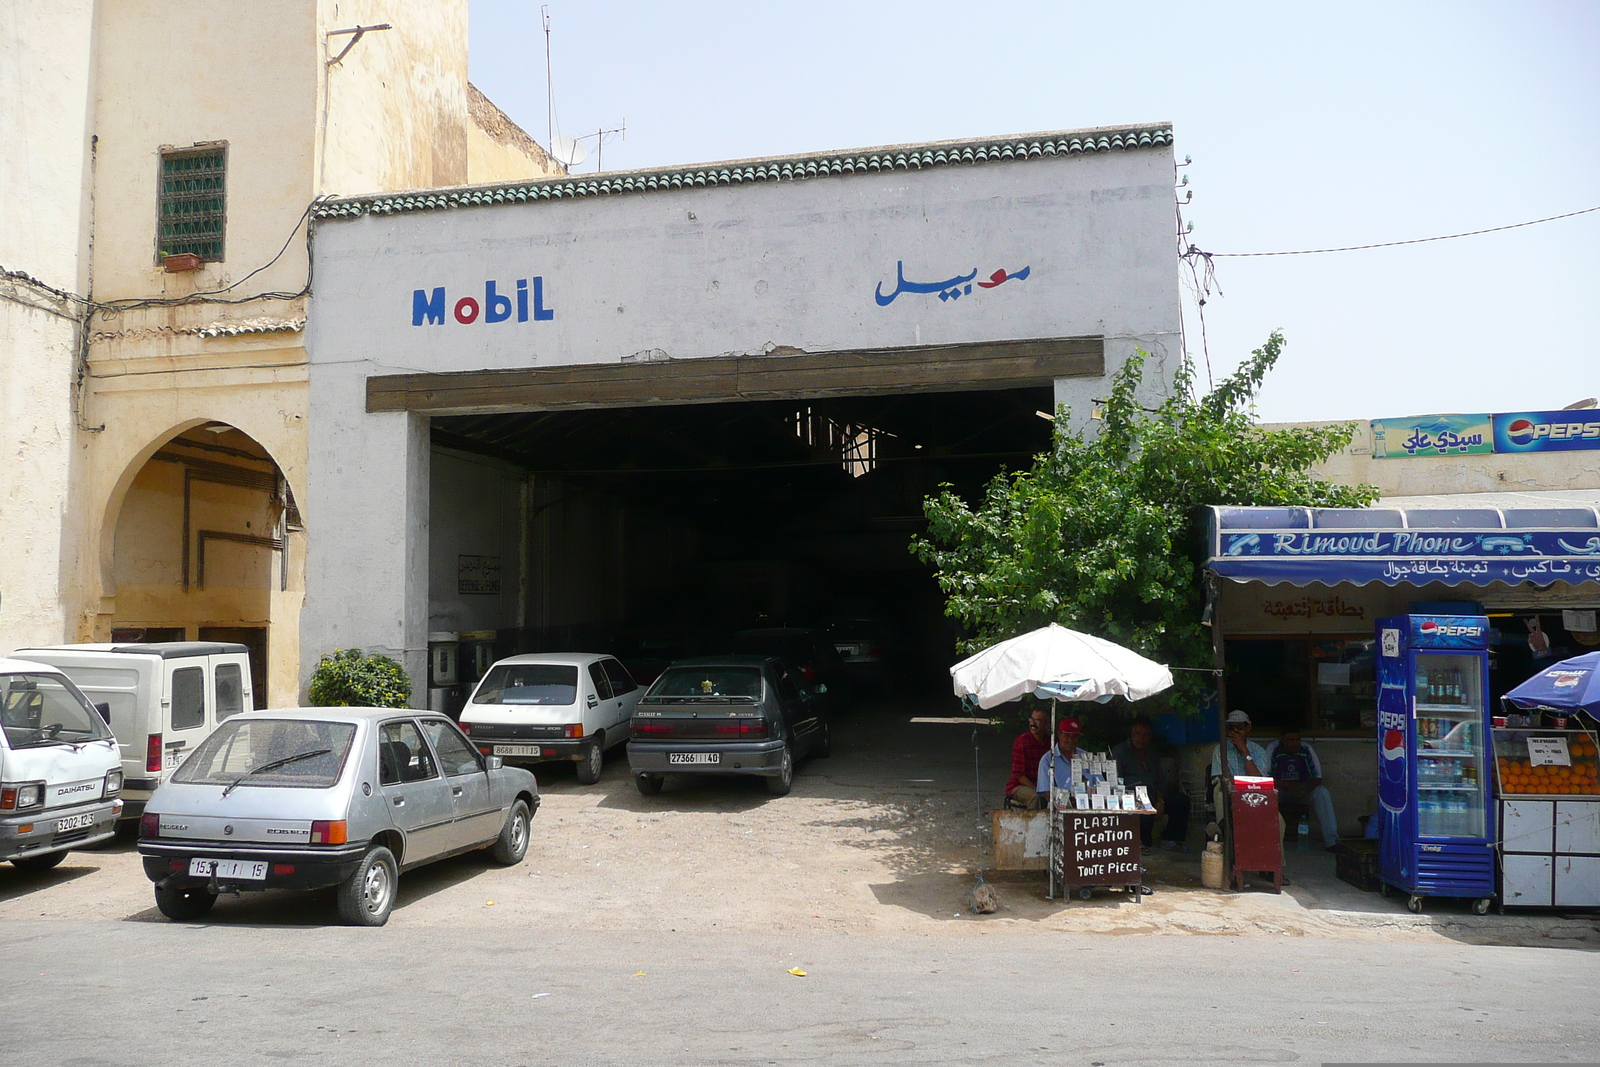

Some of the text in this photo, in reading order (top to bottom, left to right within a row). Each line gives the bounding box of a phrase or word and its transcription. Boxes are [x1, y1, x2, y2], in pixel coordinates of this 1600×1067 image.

[874, 259, 1031, 307] موبيل
[1401, 427, 1484, 454] سيدي علي
[1273, 532, 1475, 554] Rimoud Phone
[1383, 561, 1411, 580] جوال
[1410, 559, 1450, 579] بطاقة
[1511, 560, 1572, 578] فاكس
[1315, 595, 1365, 620] بطاقة
[1436, 625, 1482, 637] PEPSI
[671, 753, 695, 763] 27366
[708, 753, 718, 763] 40
[57, 783, 96, 796] DAIHATSU
[1076, 846, 1130, 862] RAPEDE DE
[1077, 864, 1105, 878] TOUTE
